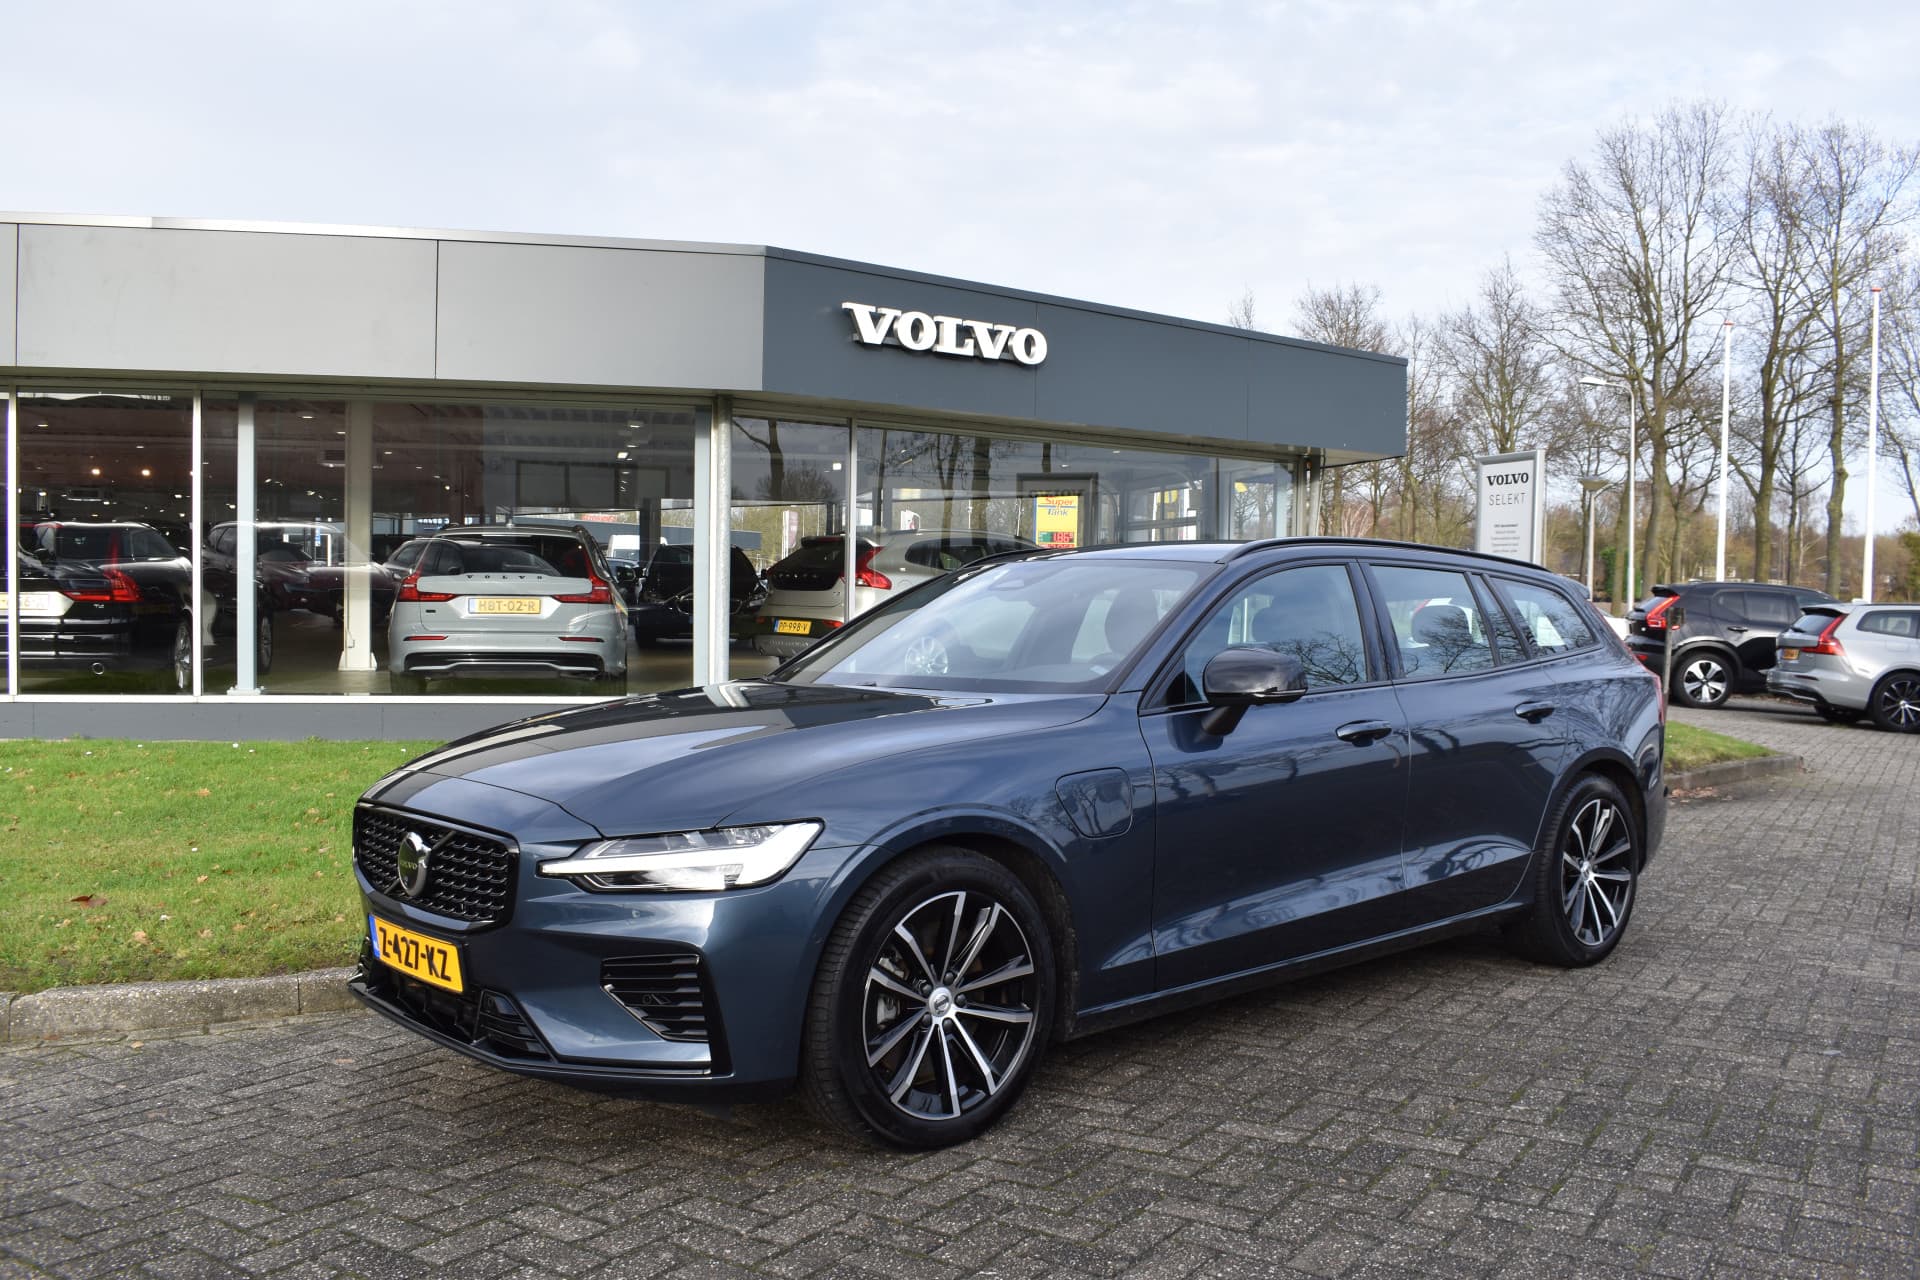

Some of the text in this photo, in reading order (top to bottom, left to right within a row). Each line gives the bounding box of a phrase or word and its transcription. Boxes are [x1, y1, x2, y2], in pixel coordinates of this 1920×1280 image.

[842, 302, 1048, 366] VOLVO
[1487, 472, 1529, 486] VOLVO
[1041, 497, 1073, 508] Super
[1489, 493, 1526, 506] SELEKT
[379, 926, 452, 982] Z-427-KZ
